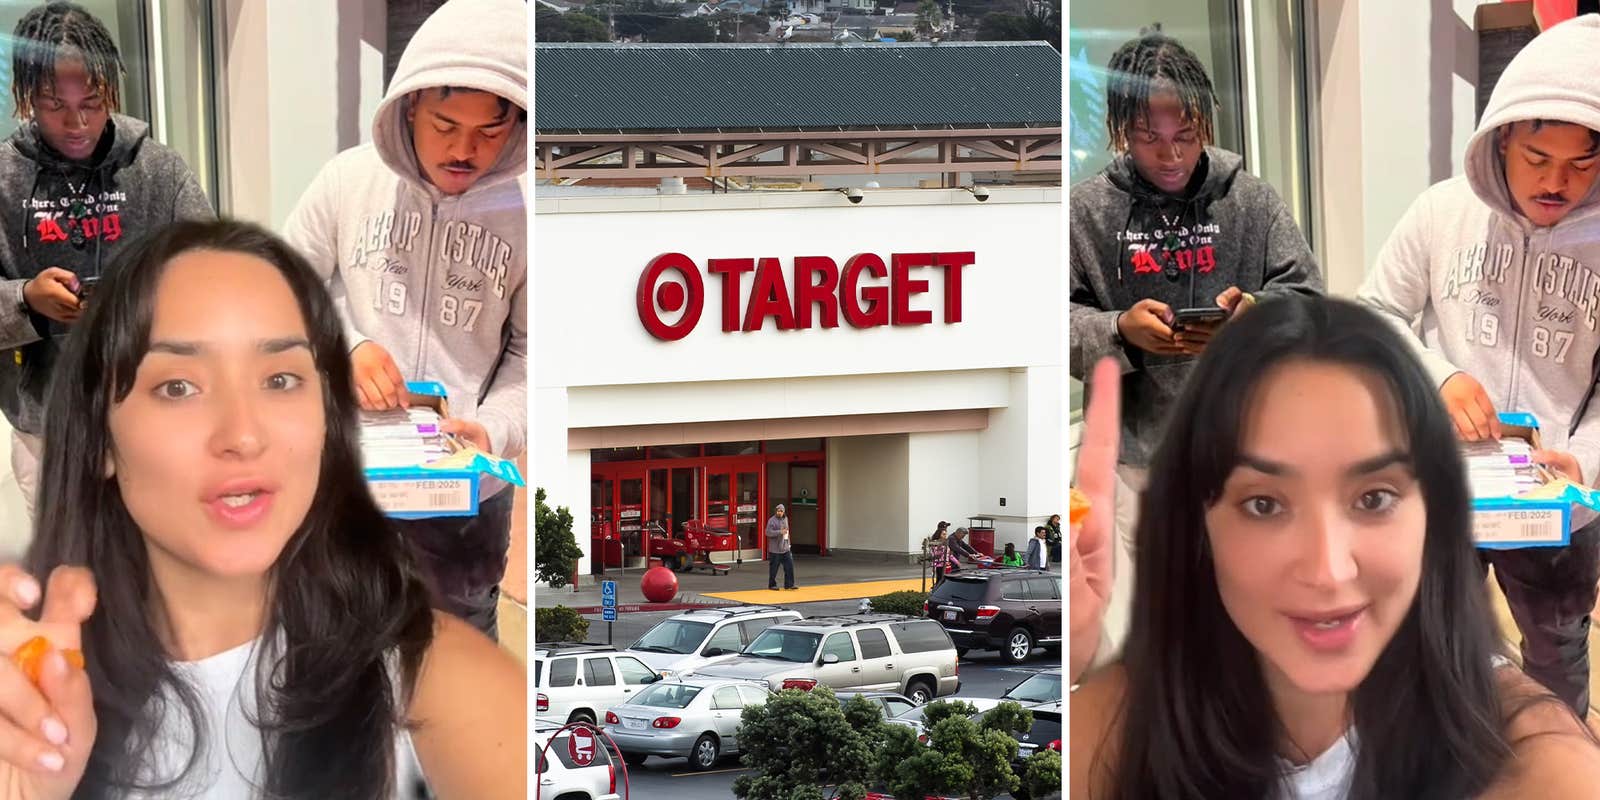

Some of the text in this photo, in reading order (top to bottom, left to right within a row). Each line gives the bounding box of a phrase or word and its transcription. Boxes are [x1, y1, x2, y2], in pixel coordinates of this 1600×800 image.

[371, 257, 485, 292] New York
[708, 251, 975, 332] TARGET
[374, 277, 484, 333] 19 87
[1464, 289, 1575, 324] New York
[1465, 309, 1575, 365] 19 87
